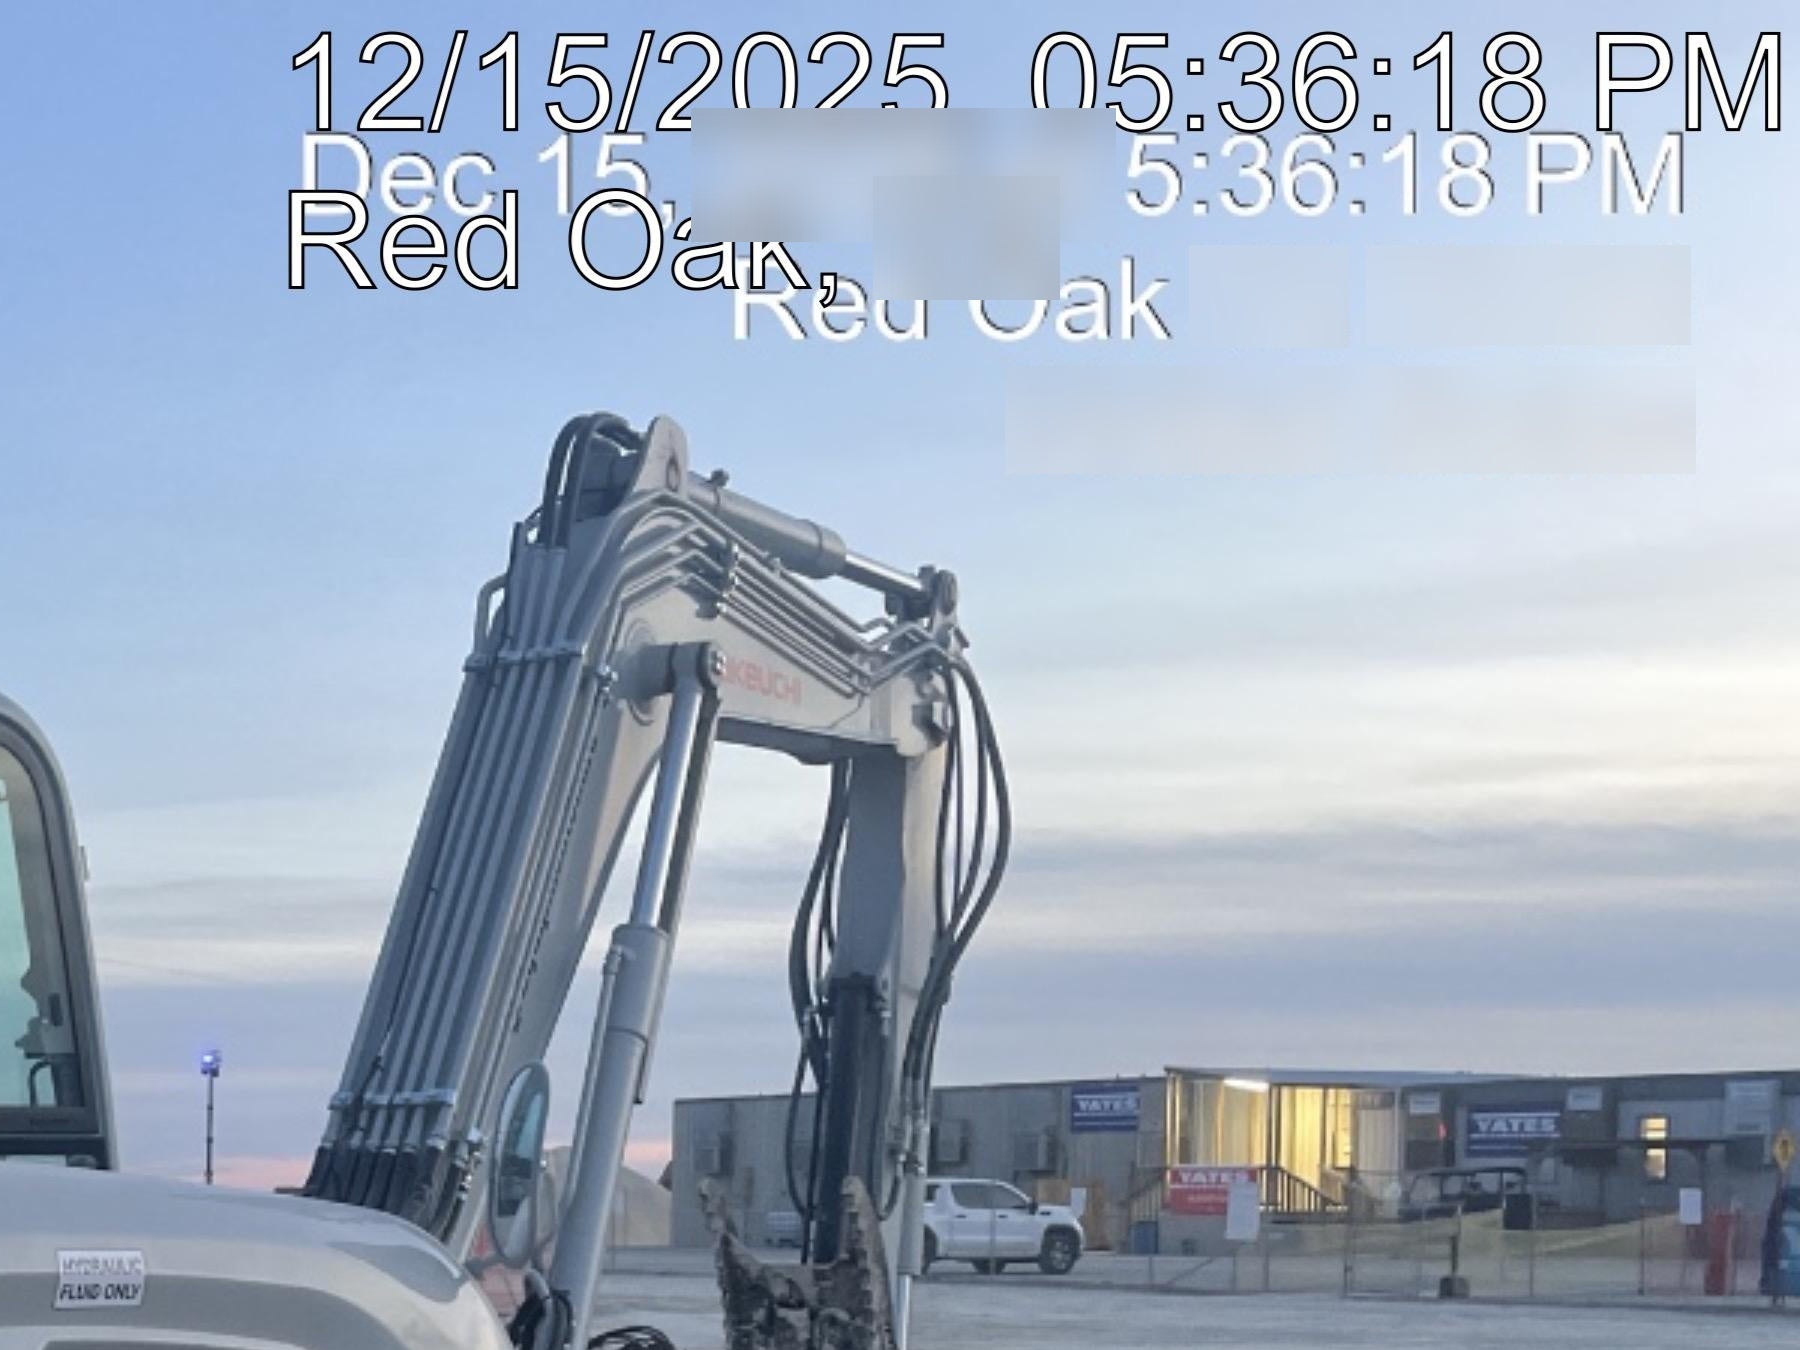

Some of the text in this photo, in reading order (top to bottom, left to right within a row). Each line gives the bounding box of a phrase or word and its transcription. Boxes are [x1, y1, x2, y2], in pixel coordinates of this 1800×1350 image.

[1078, 1097, 1138, 1112] YATES
[1475, 1118, 1557, 1133] YATES
[1178, 1170, 1249, 1184] YATES
[60, 1283, 142, 1300] FLUID ONLY
